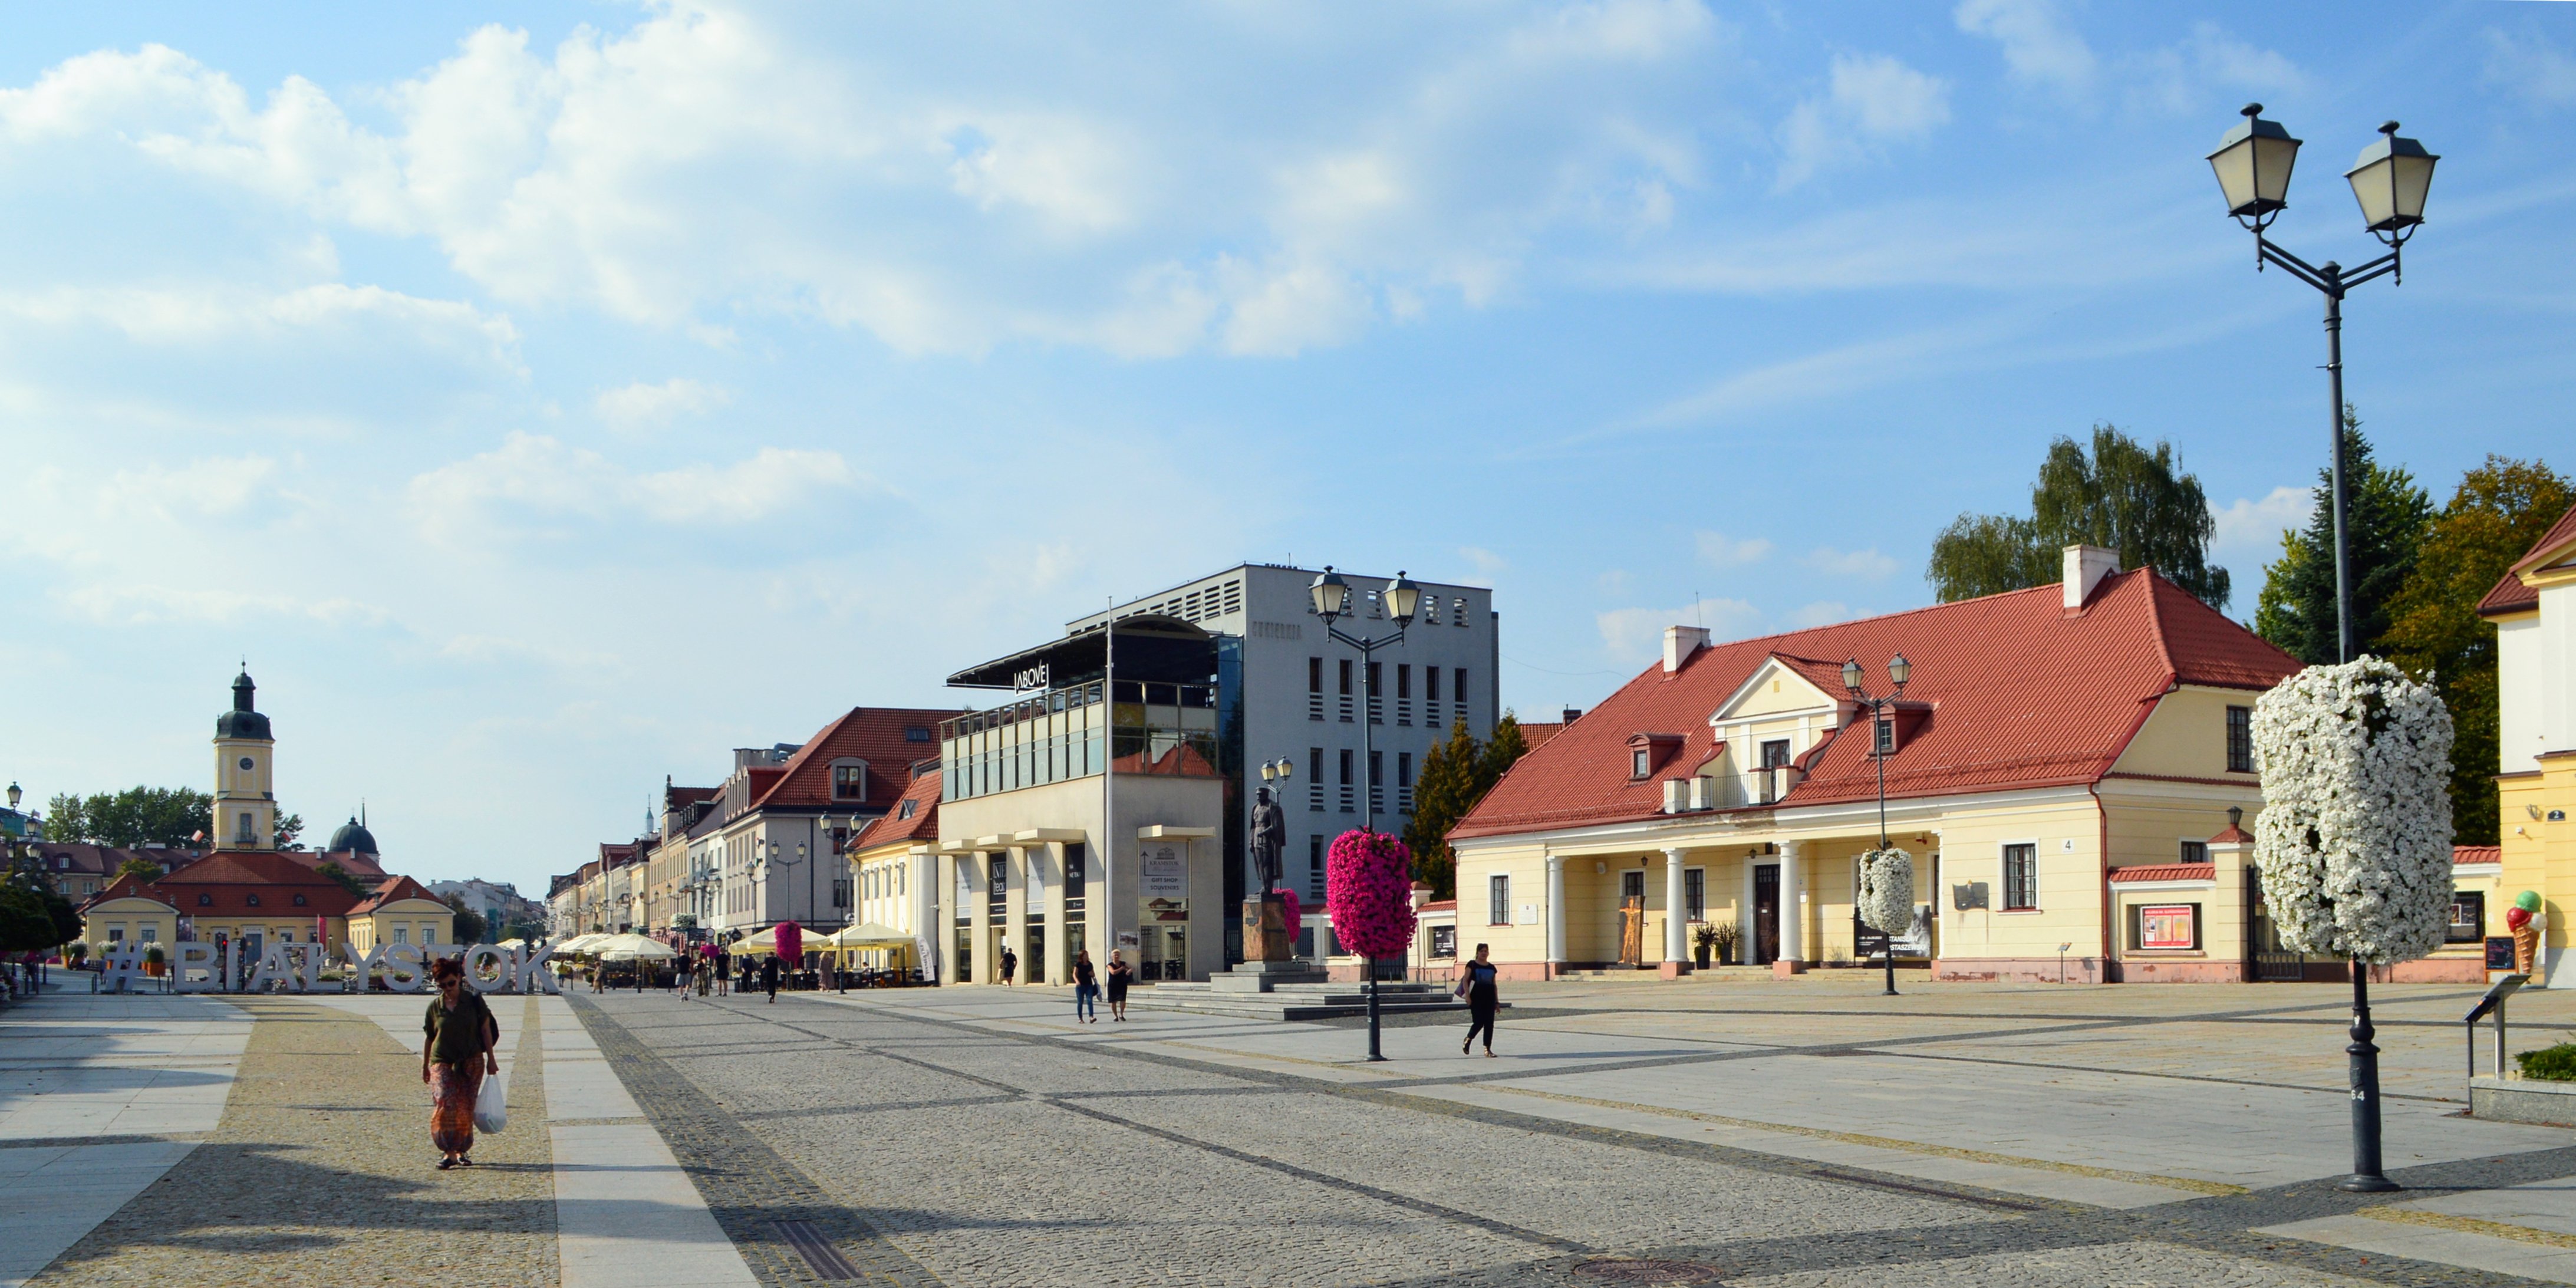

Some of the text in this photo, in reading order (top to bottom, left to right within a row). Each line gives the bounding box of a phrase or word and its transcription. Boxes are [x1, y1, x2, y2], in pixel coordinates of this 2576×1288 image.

[1017, 659, 1046, 689] ABOVE
[2554, 811, 2559, 819] 2
[2065, 840, 2071, 850] 4
[2351, 1089, 2365, 1101] 64
